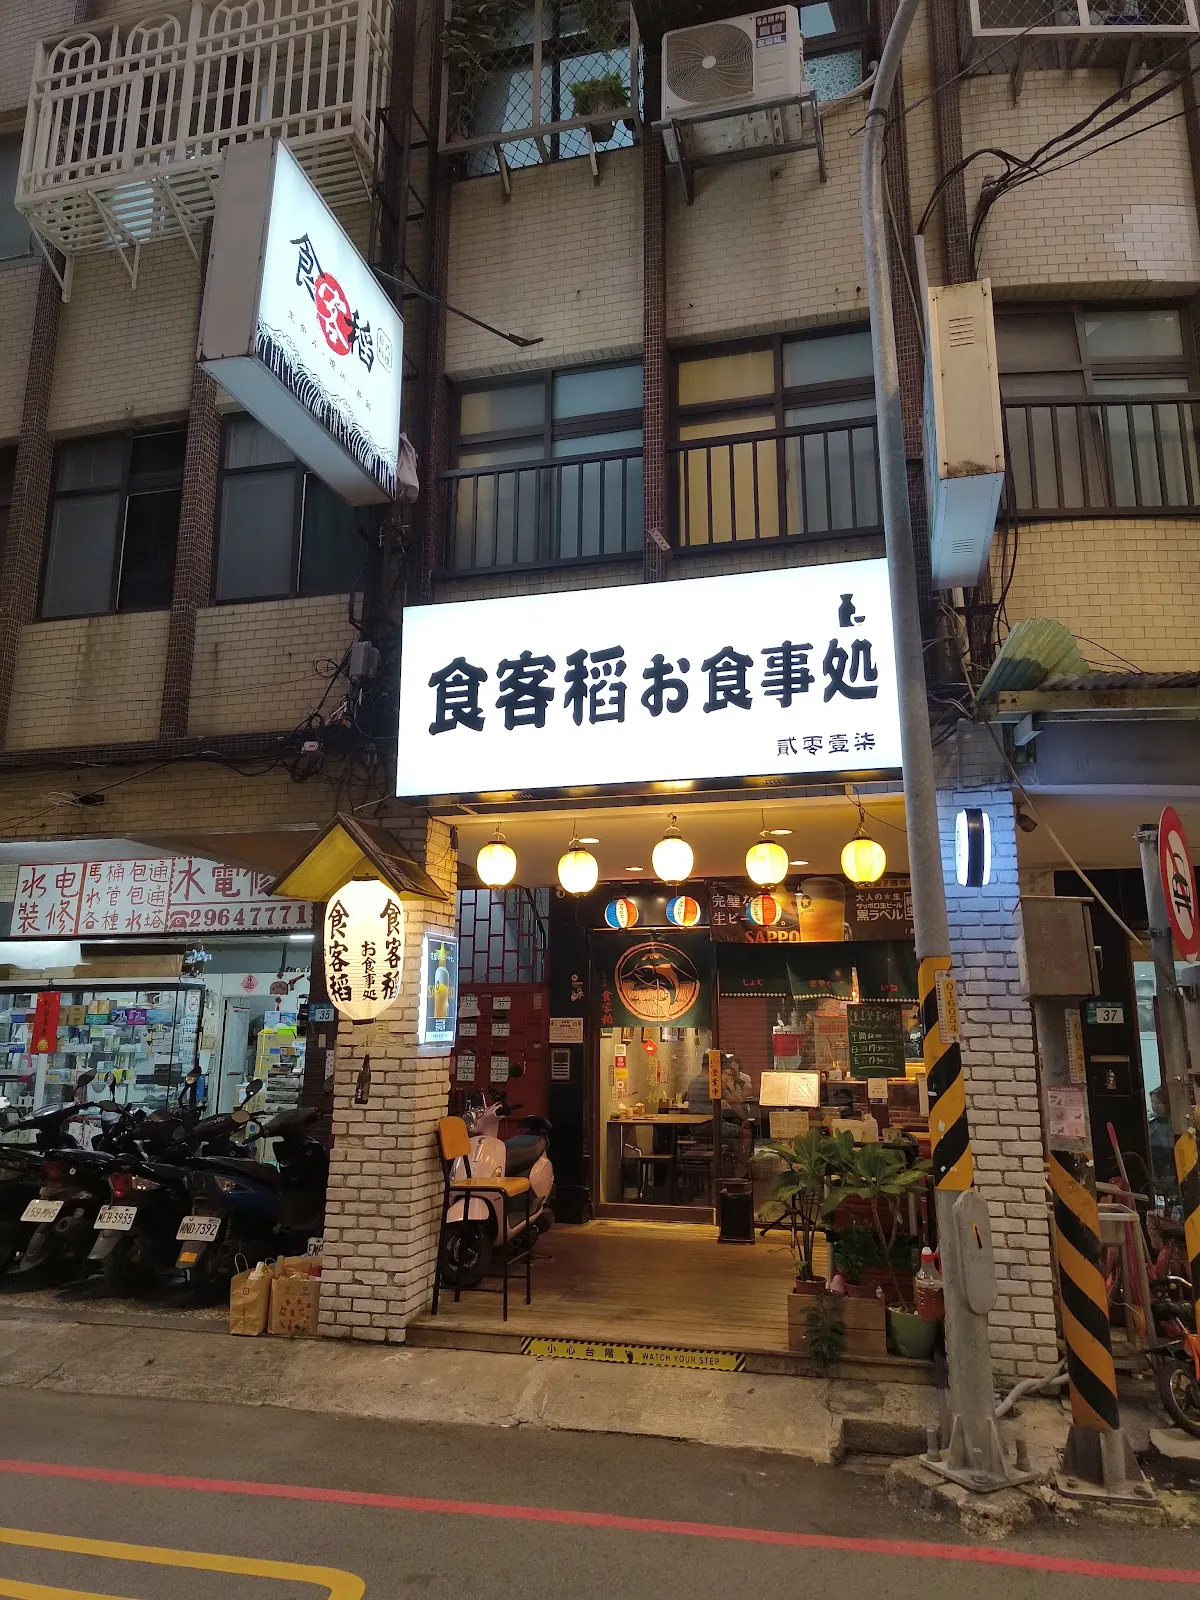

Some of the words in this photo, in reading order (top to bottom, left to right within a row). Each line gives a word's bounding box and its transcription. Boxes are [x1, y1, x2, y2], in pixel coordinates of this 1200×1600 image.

[756, 13, 786, 26] SAMPO
[776, 731, 877, 757] 貳零壹柒
[188, 904, 307, 928] 29647771
[856, 908, 904, 922] 黒ラベル
[361, 940, 378, 1001] お食事処
[945, 982, 959, 1032] 016054
[319, 1009, 331, 1020] 35
[1103, 1009, 1118, 1022] 37
[178, 1222, 218, 1236] MND-7392
[547, 1343, 615, 1359] 小心台階
[642, 1352, 671, 1362] WATCH
[674, 1354, 697, 1364] YOUR
[699, 1356, 721, 1366] STEP
